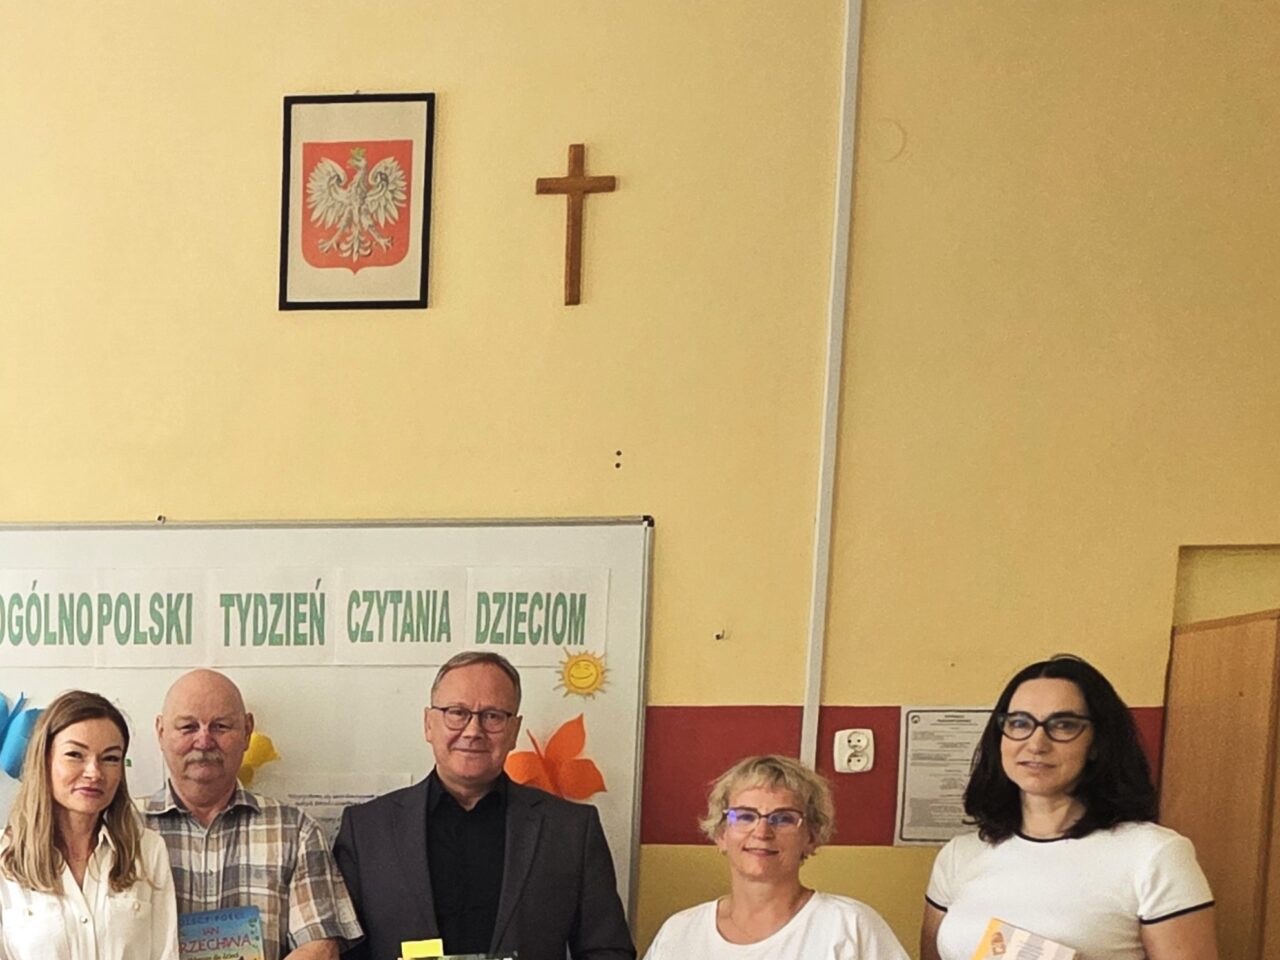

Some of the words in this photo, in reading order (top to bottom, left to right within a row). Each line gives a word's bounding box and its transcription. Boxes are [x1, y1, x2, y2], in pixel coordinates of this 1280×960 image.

[220, 578, 325, 647] TYDZIEŃ
[347, 589, 452, 643] CZYTANIA
[475, 591, 587, 645] DZIECIOM
[179, 933, 251, 953] RZECHWA
